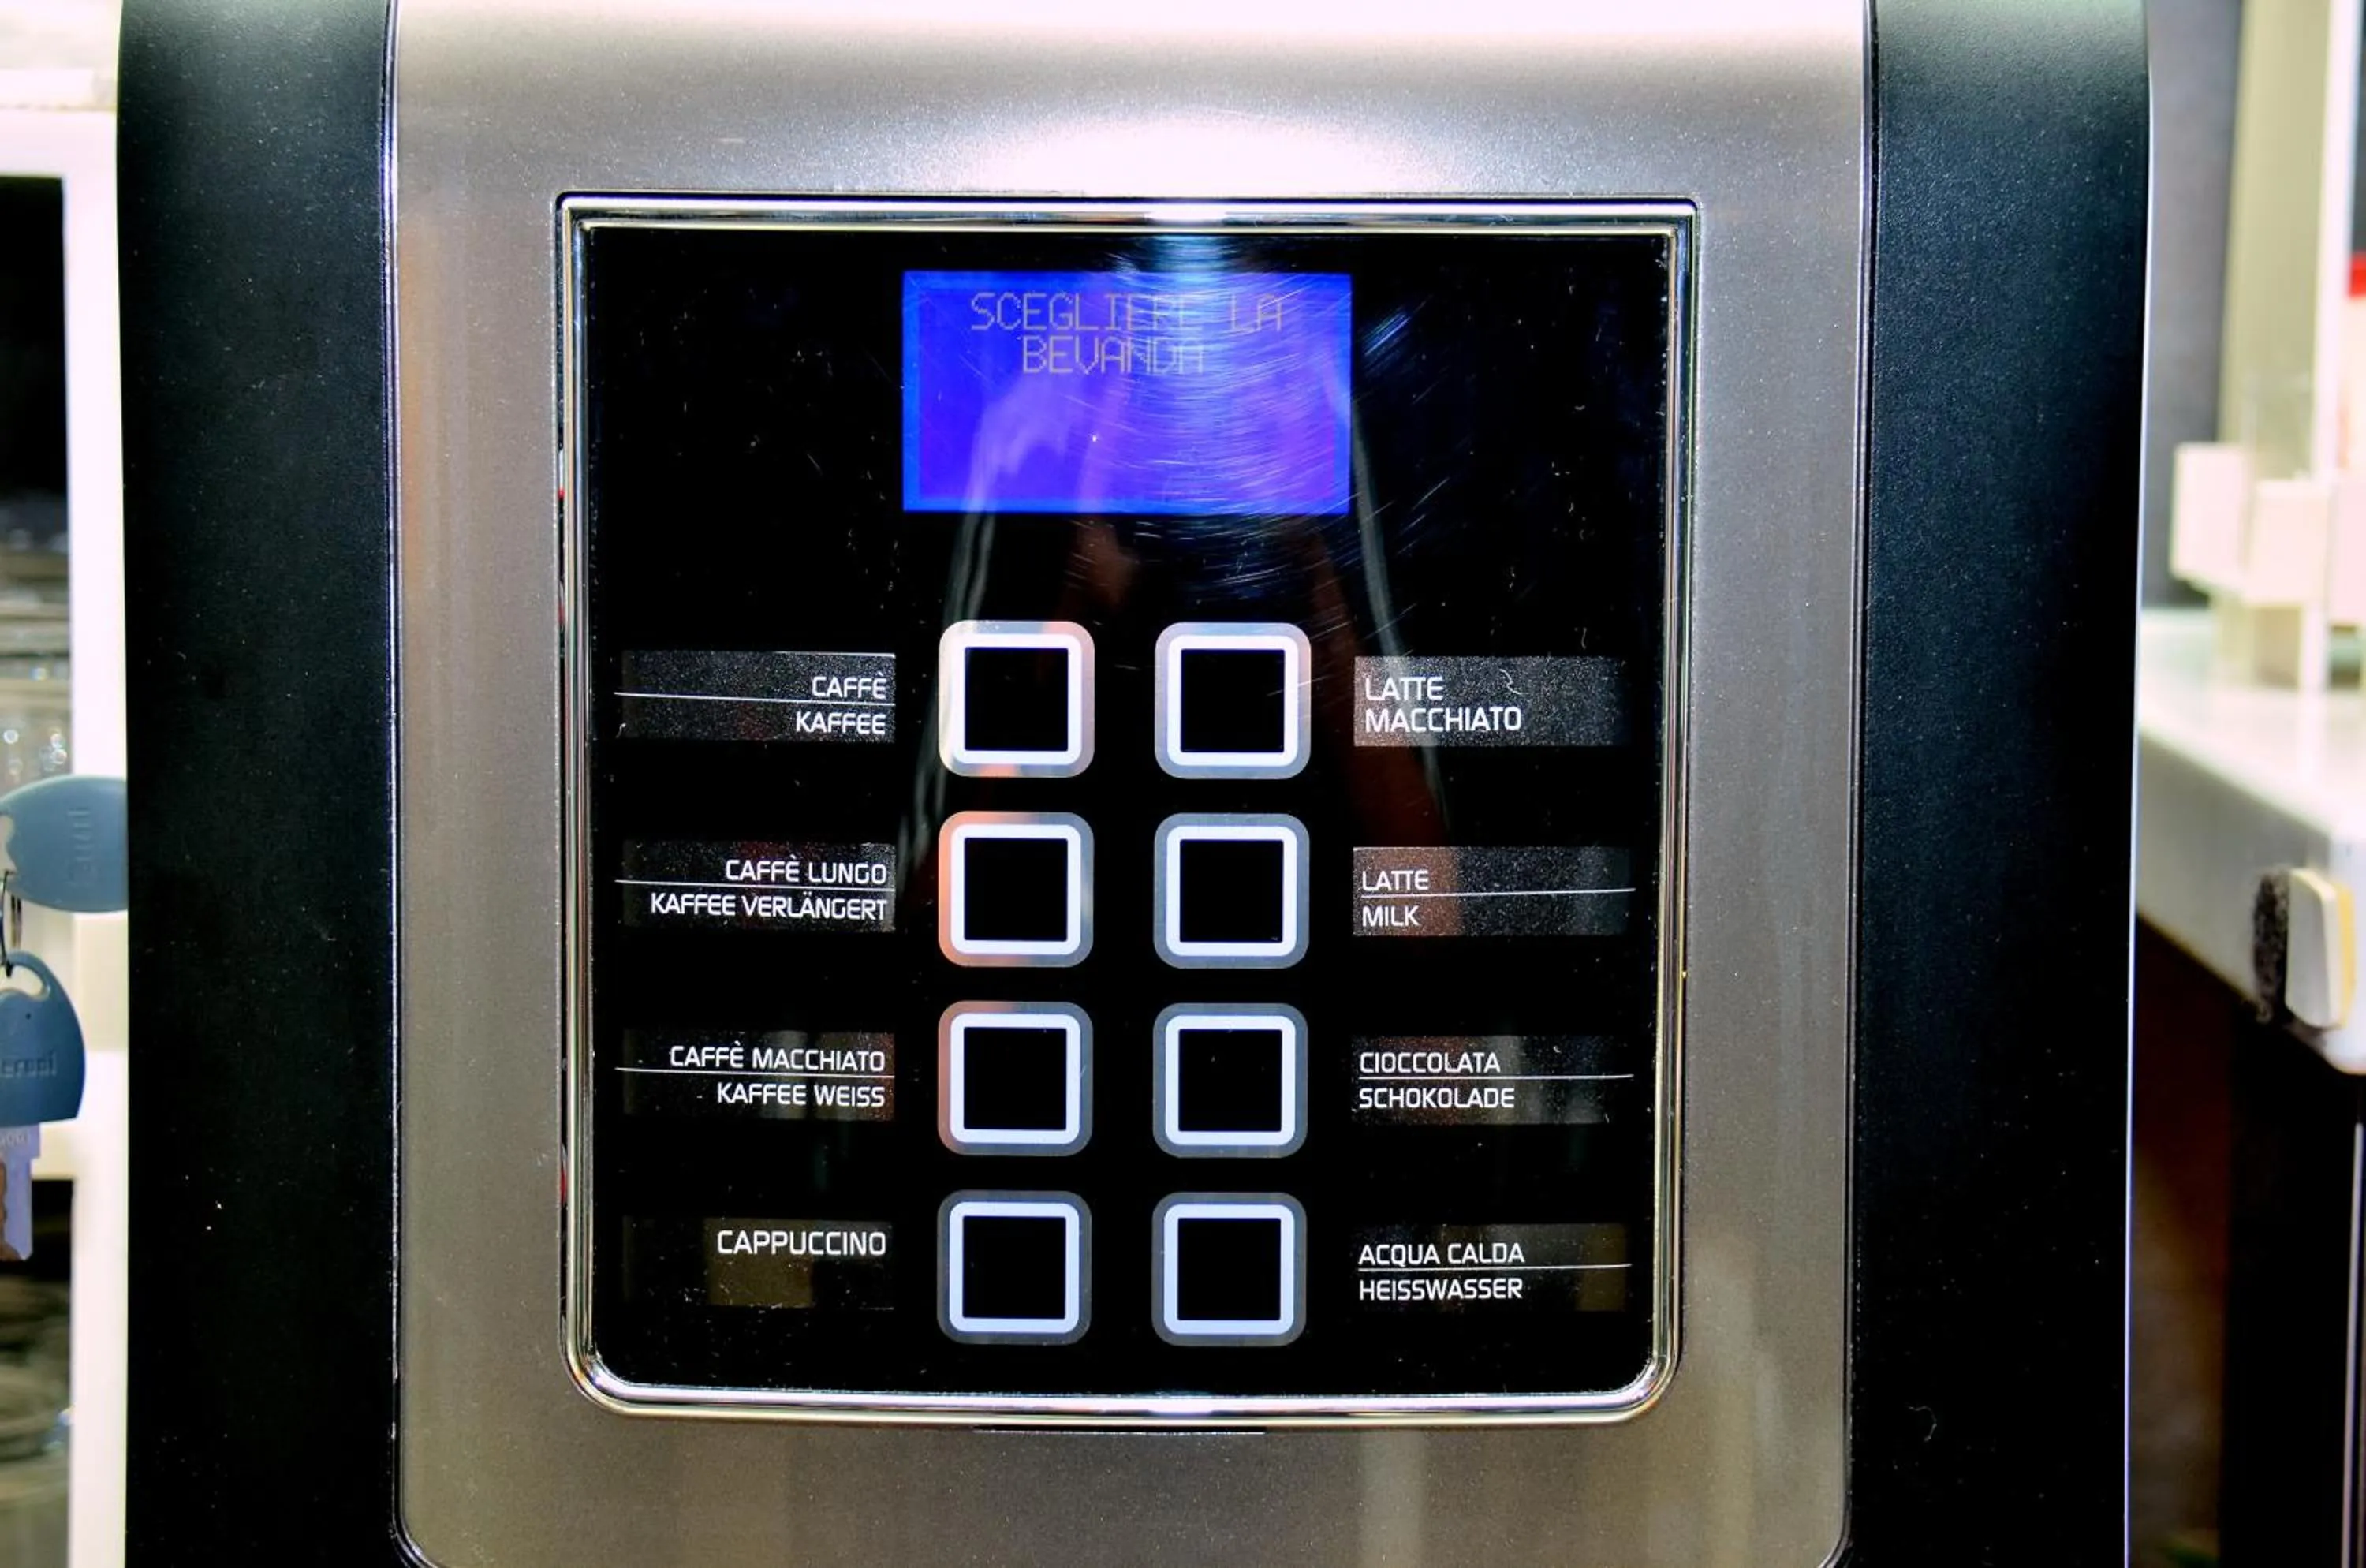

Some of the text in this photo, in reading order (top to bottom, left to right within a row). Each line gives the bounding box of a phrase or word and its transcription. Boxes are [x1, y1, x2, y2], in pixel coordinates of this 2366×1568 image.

[1230, 292, 1283, 333] LA
[1022, 335, 1204, 374] BEVANDA
[812, 671, 887, 700] CAFFÈ
[1365, 676, 1444, 701] LATTE
[796, 711, 886, 735] KAFFEE
[1365, 706, 1522, 732] MACCHIATO
[725, 854, 887, 884] CAFFÈ LUNGO
[1361, 870, 1430, 891] LATTE
[651, 890, 887, 920] KAFFEE VERLÄNGERT
[1361, 905, 1419, 927] MILK
[670, 1040, 885, 1072] CAFFÈ MACCHIATO
[1360, 1051, 1501, 1073] CIOCCOLATA
[717, 1082, 885, 1107] KAFFEE WEISS
[1359, 1088, 1515, 1109] SCHOKOLADE
[717, 1230, 886, 1256] CAPPUCCINO
[1358, 1242, 1525, 1267] ACQUA CALDA
[1360, 1278, 1523, 1301] HEISSWASSER
